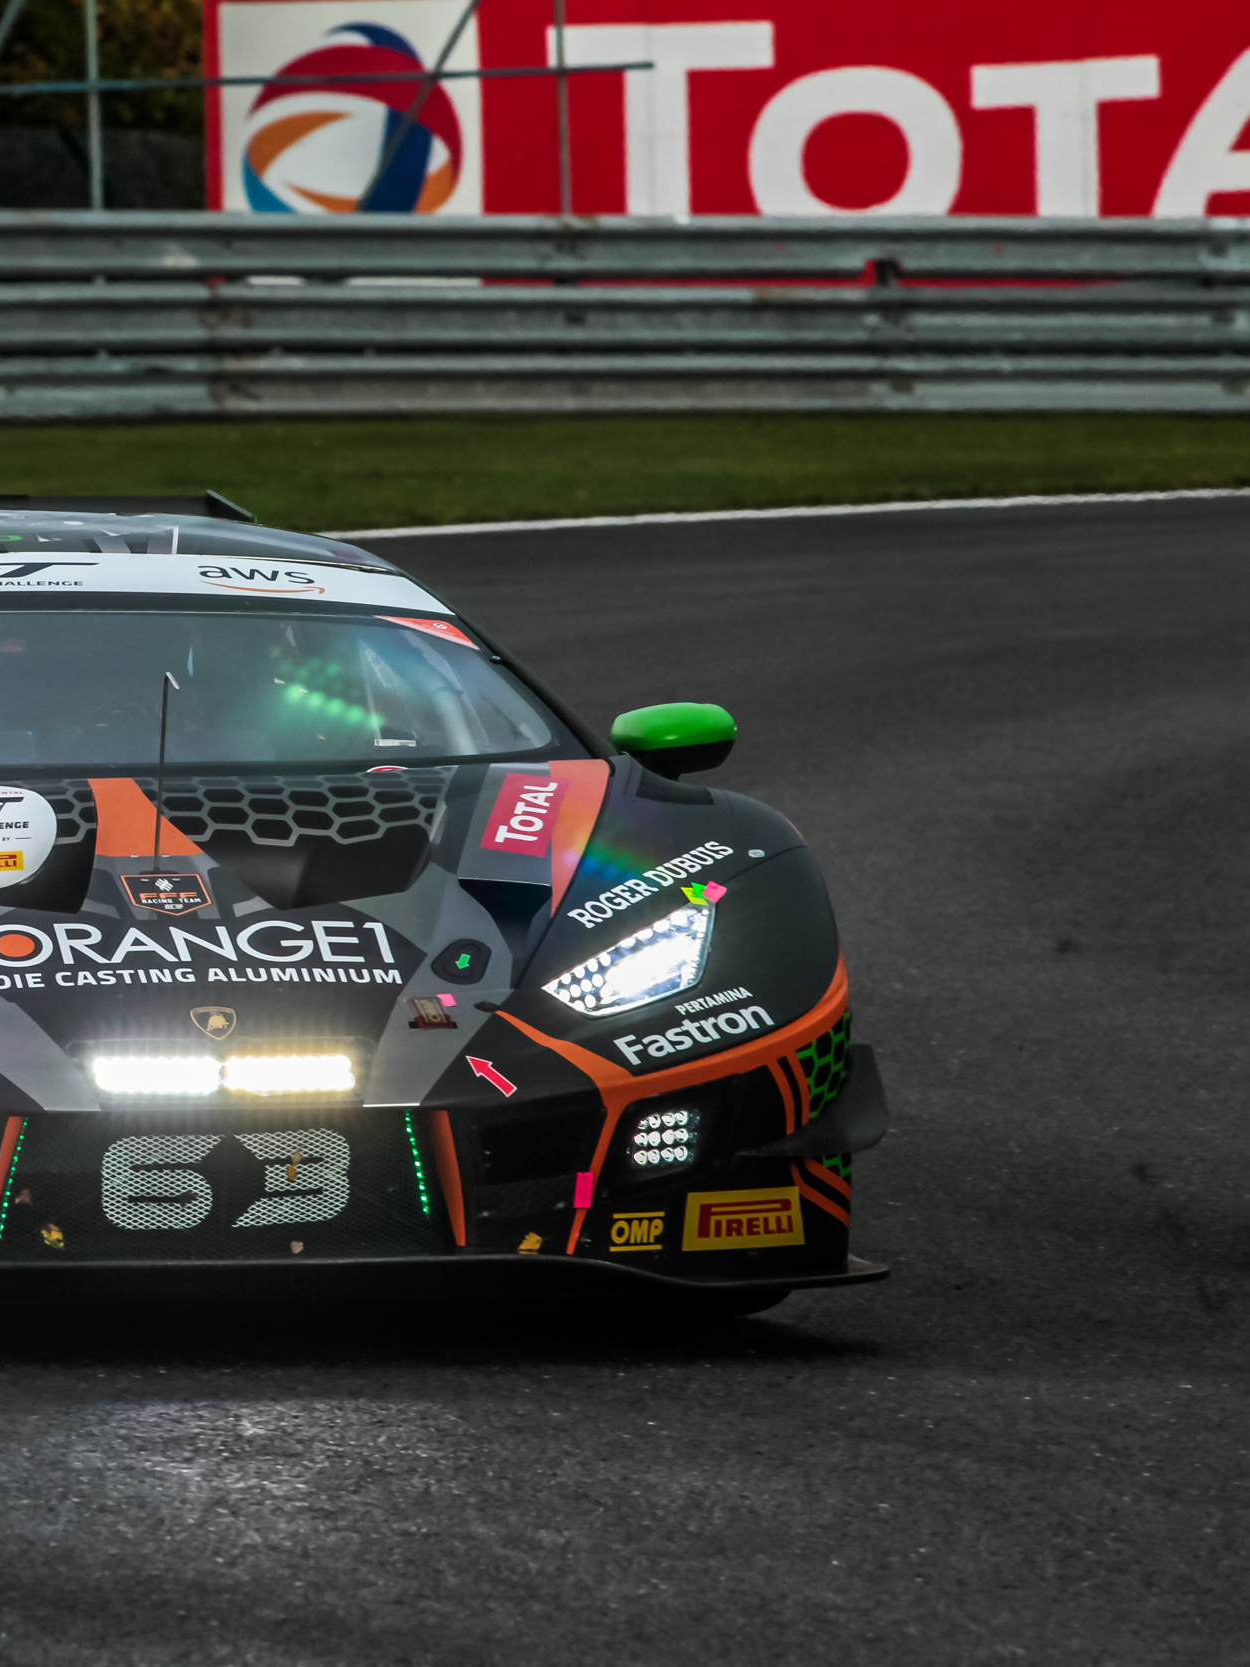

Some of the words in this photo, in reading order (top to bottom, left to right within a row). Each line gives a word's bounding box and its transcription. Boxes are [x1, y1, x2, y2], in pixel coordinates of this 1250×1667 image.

[197, 565, 316, 585] aws
[495, 780, 558, 844] TOTAL
[568, 870, 653, 928] ROGER
[648, 840, 733, 890] DUBUIS
[56, 968, 196, 987] CASTING
[207, 967, 402, 985] ALUMINIUM
[675, 986, 753, 1016] PERTAMINA
[613, 1004, 775, 1065] Fastron
[101, 1128, 350, 1230] 63
[611, 1216, 663, 1245] OMP
[697, 1198, 793, 1239] PIRELLI
